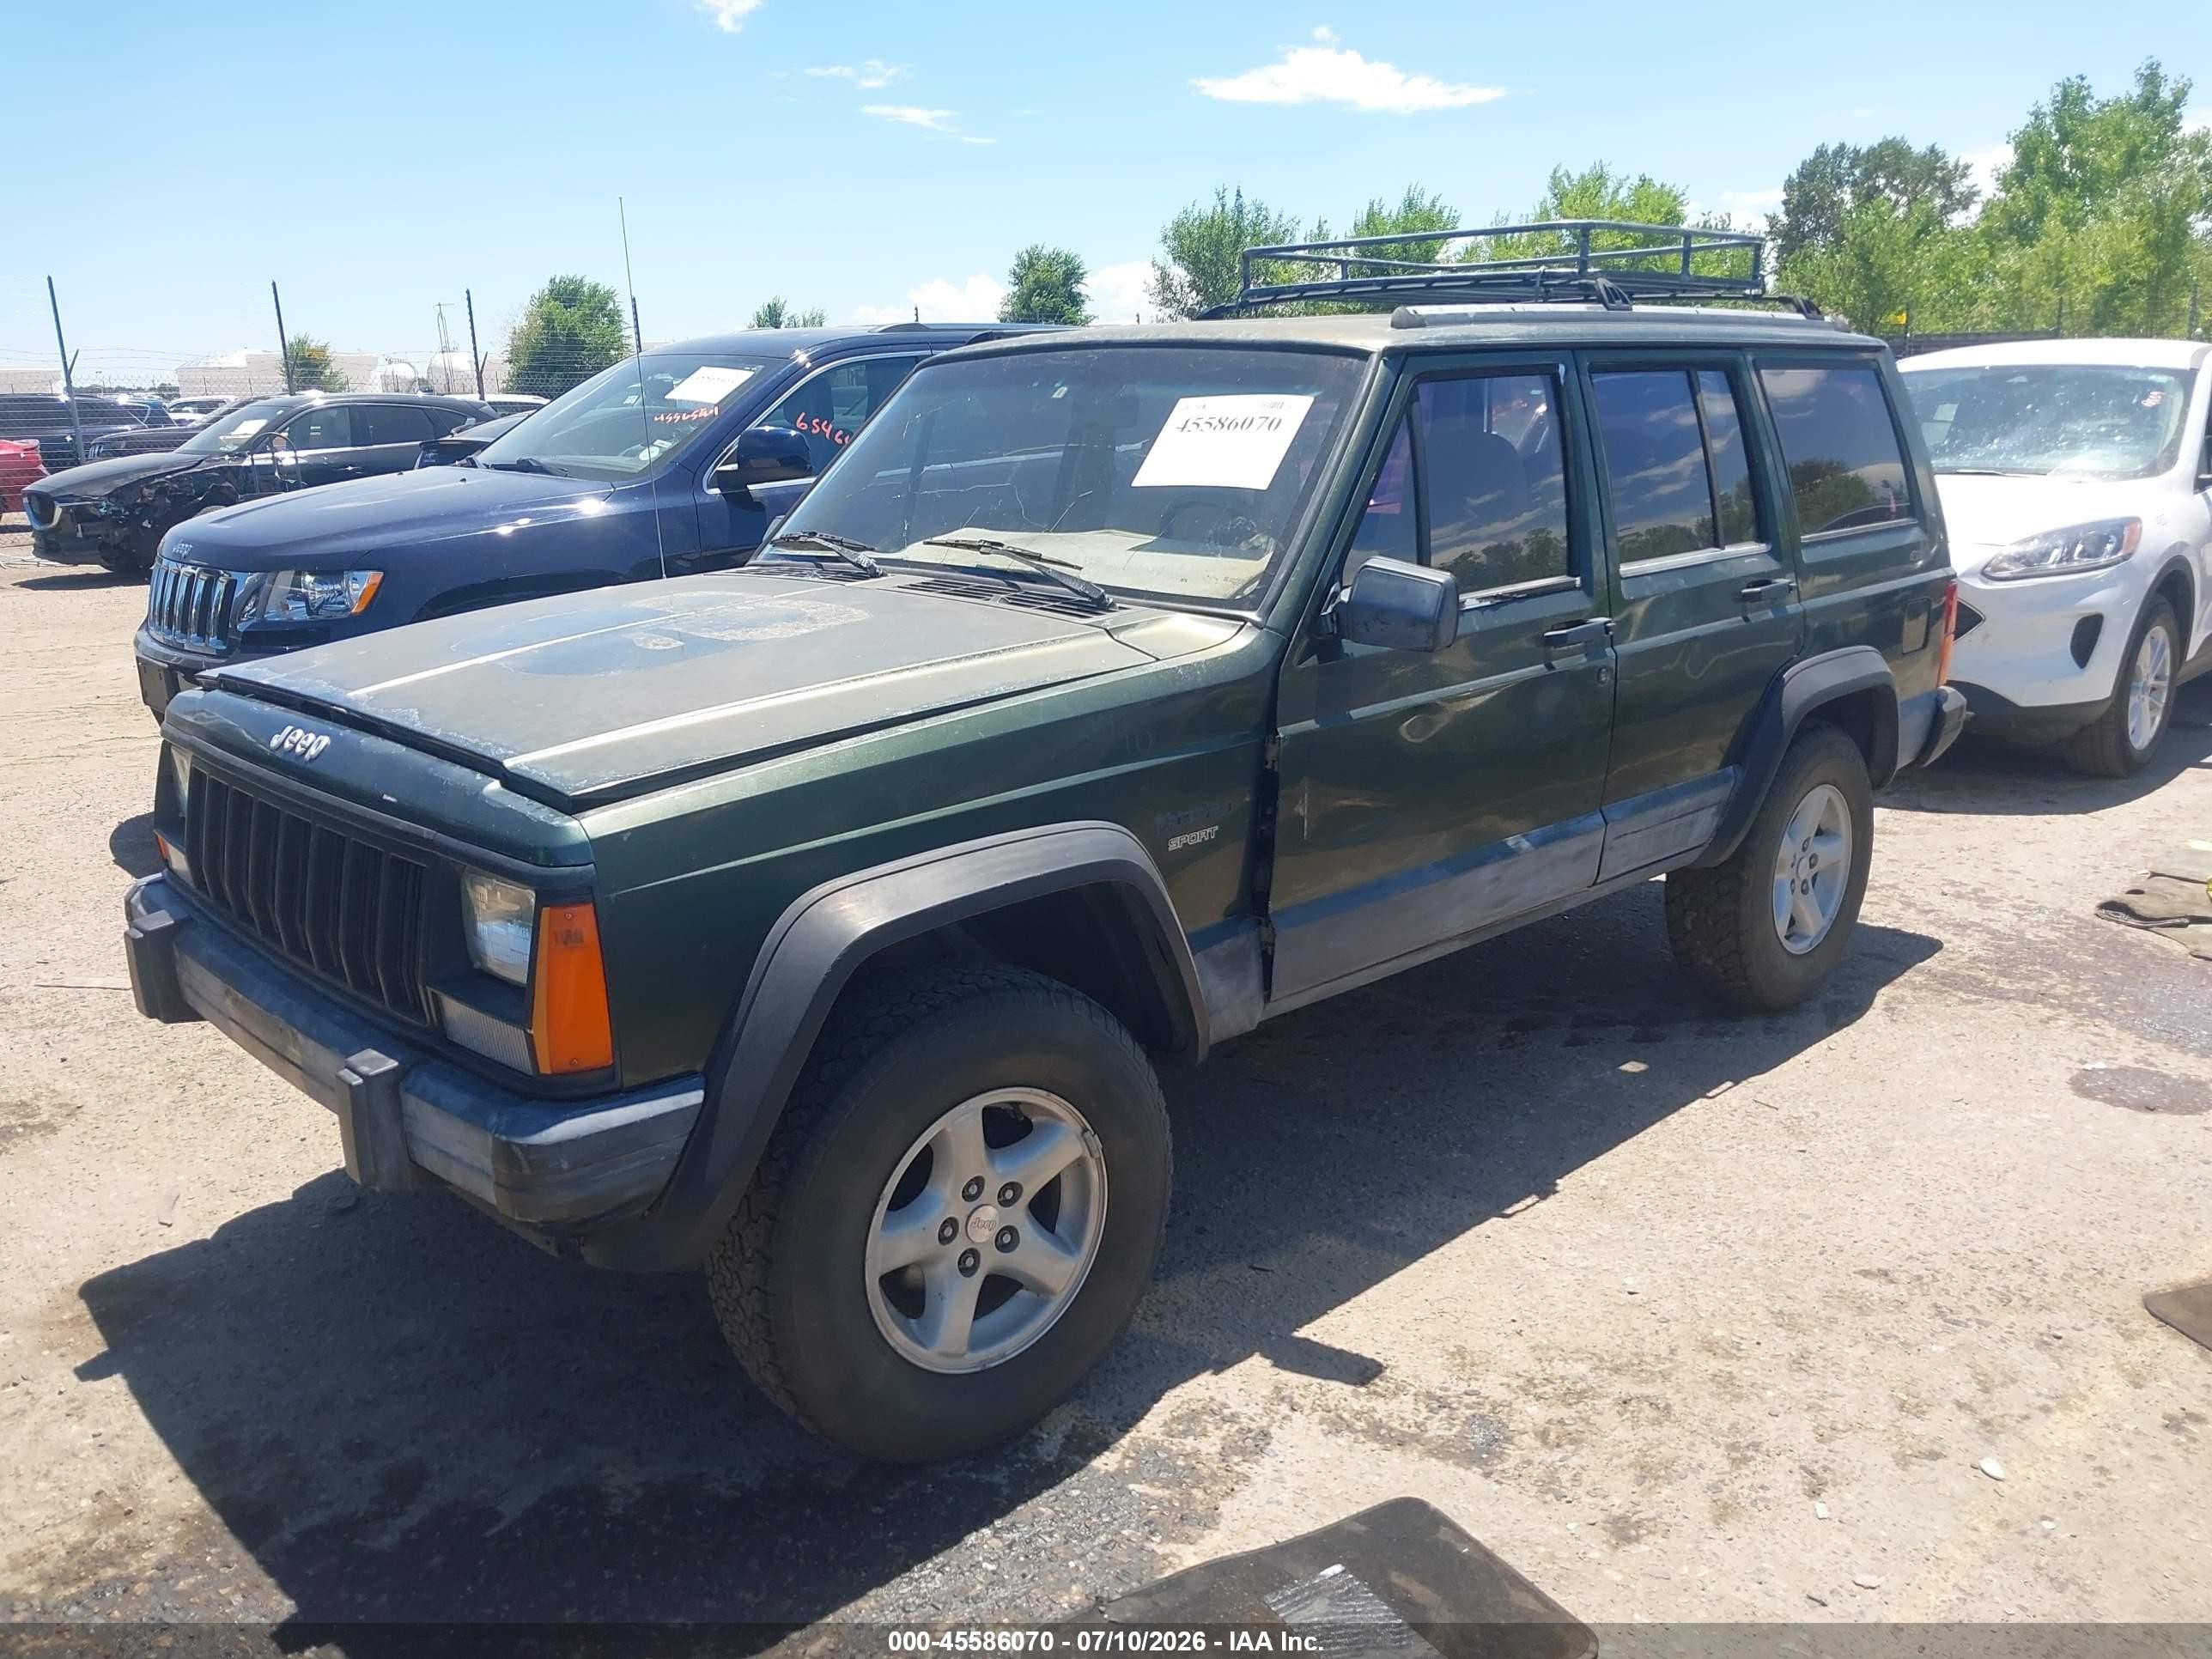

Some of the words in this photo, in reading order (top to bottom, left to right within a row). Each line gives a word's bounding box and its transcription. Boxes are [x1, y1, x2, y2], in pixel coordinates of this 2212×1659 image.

[1176, 416, 1283, 433] 45586070
[270, 725, 331, 761] Jeep
[1167, 825, 1219, 852] SPORT
[971, 1217, 996, 1231] Jeep
